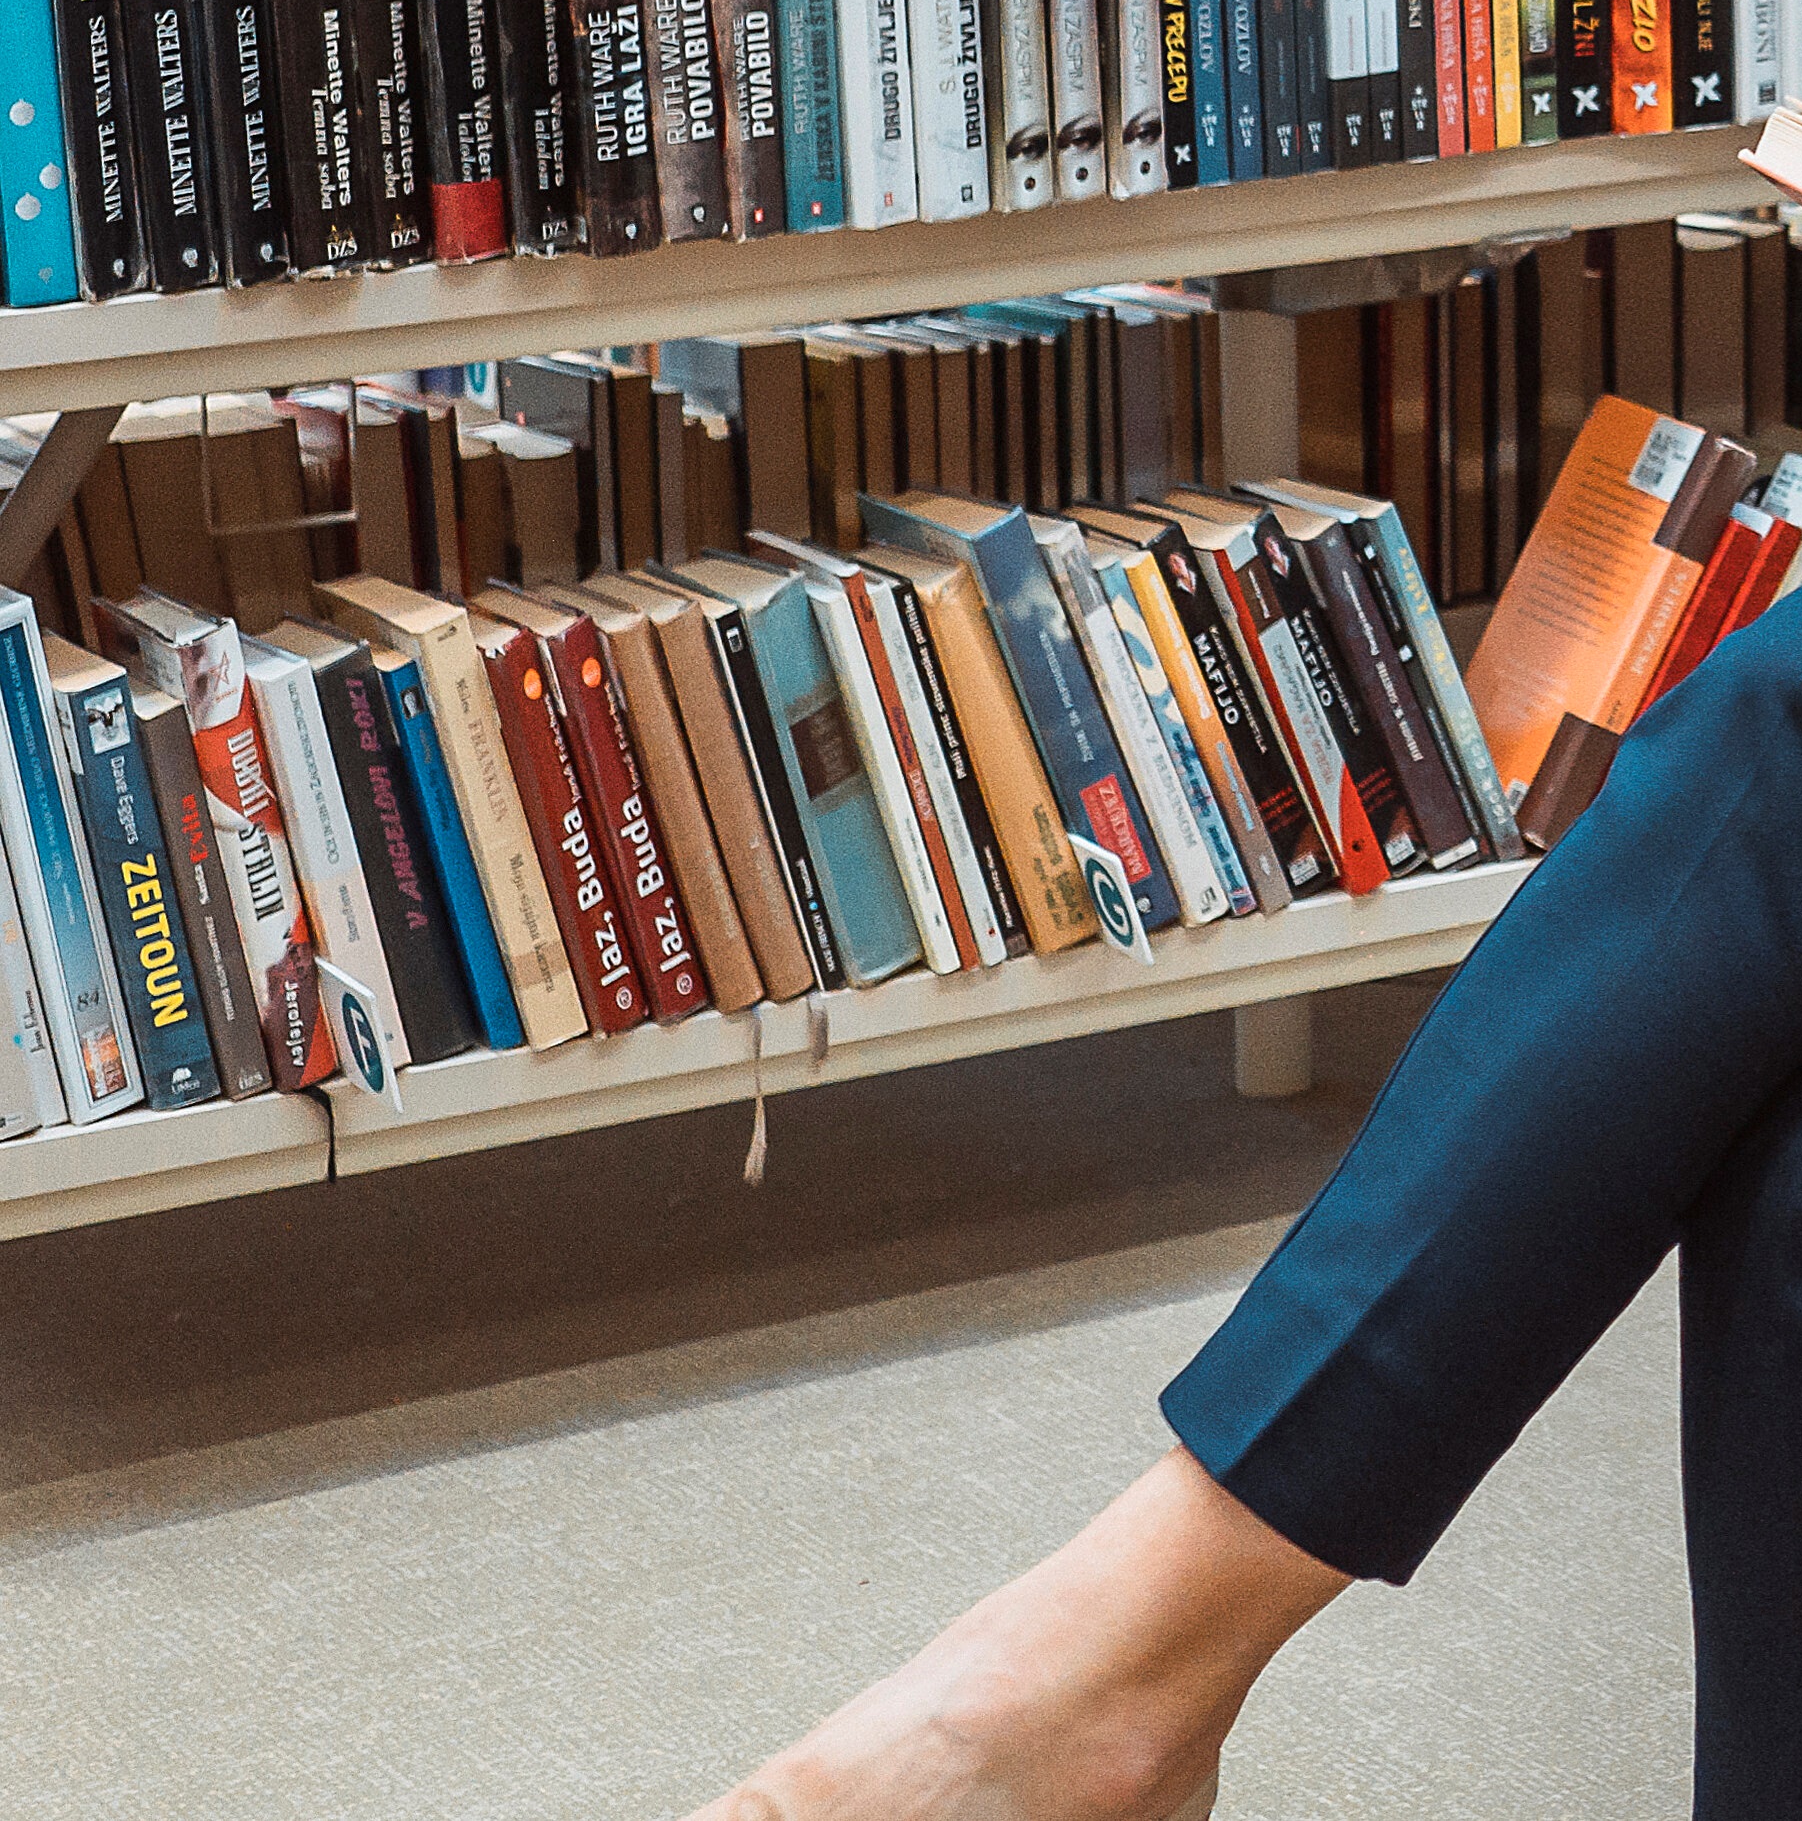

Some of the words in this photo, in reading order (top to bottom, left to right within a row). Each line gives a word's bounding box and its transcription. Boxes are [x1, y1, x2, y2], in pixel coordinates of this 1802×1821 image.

[88, 14, 112, 119] WALTERS
[153, 8, 187, 111] WALTERS
[234, 4, 263, 109] WALTERS
[322, 8, 347, 105] Minette
[389, 0, 412, 94] Minette
[587, 9, 616, 88] WARE
[611, 2, 643, 73] LAŽI
[732, 13, 747, 80] WARE
[745, 10, 776, 139] POVABILO
[1164, 10, 1189, 104] PRECEPU
[310, 84, 333, 145] Temna
[376, 75, 396, 145] Temna
[394, 100, 419, 196] Walters
[547, 90, 567, 188] Walters
[594, 90, 620, 162] RUTH
[622, 79, 649, 158] IGRA
[663, 74, 689, 146] RUTH
[736, 82, 751, 142] RUTH
[880, 71, 902, 142] DRUGO
[961, 71, 984, 150] DRUGO
[98, 120, 124, 224] MINETTE
[165, 114, 198, 217] MINETTE
[242, 104, 273, 212] MINETTE
[315, 153, 337, 211] soba
[330, 112, 357, 208] Walters
[382, 150, 402, 200] soba
[1192, 632, 1240, 726] MAFIJO
[1288, 615, 1334, 708] MAFIJO
[108, 754, 130, 790] Dave
[115, 794, 142, 846] Eggers
[560, 804, 605, 912] Buda
[619, 792, 666, 899] Buda
[120, 853, 190, 1027] ZEITOUN
[593, 909, 631, 988] Jaz,
[653, 896, 692, 975] Jaz,
[282, 978, 307, 1069] Jerofejev
